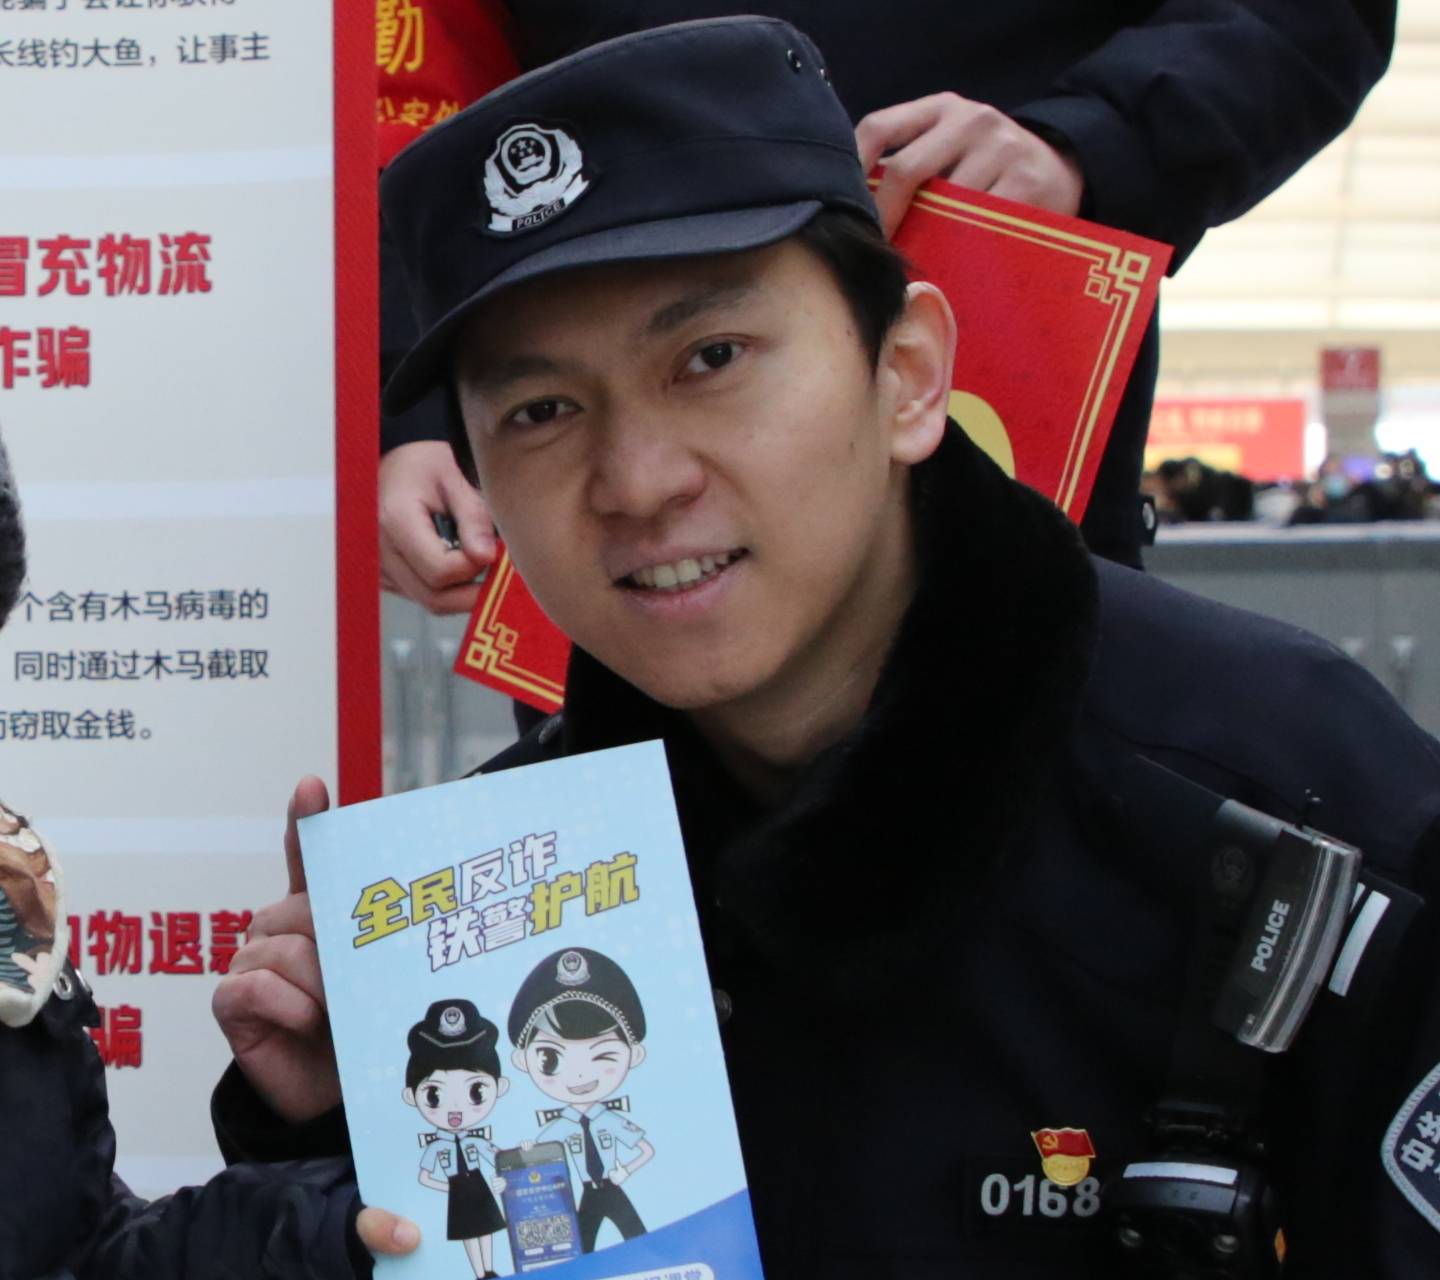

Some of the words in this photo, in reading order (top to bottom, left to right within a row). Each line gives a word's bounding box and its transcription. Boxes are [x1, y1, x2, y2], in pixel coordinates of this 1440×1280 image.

[516, 200, 561, 229] POLICE
[351, 831, 557, 948] 全民反诈
[427, 851, 640, 972] 铁警护航
[67, 910, 253, 976] 物退款
[1251, 899, 1291, 973] POLICE
[981, 1173, 1100, 1218] 0168
